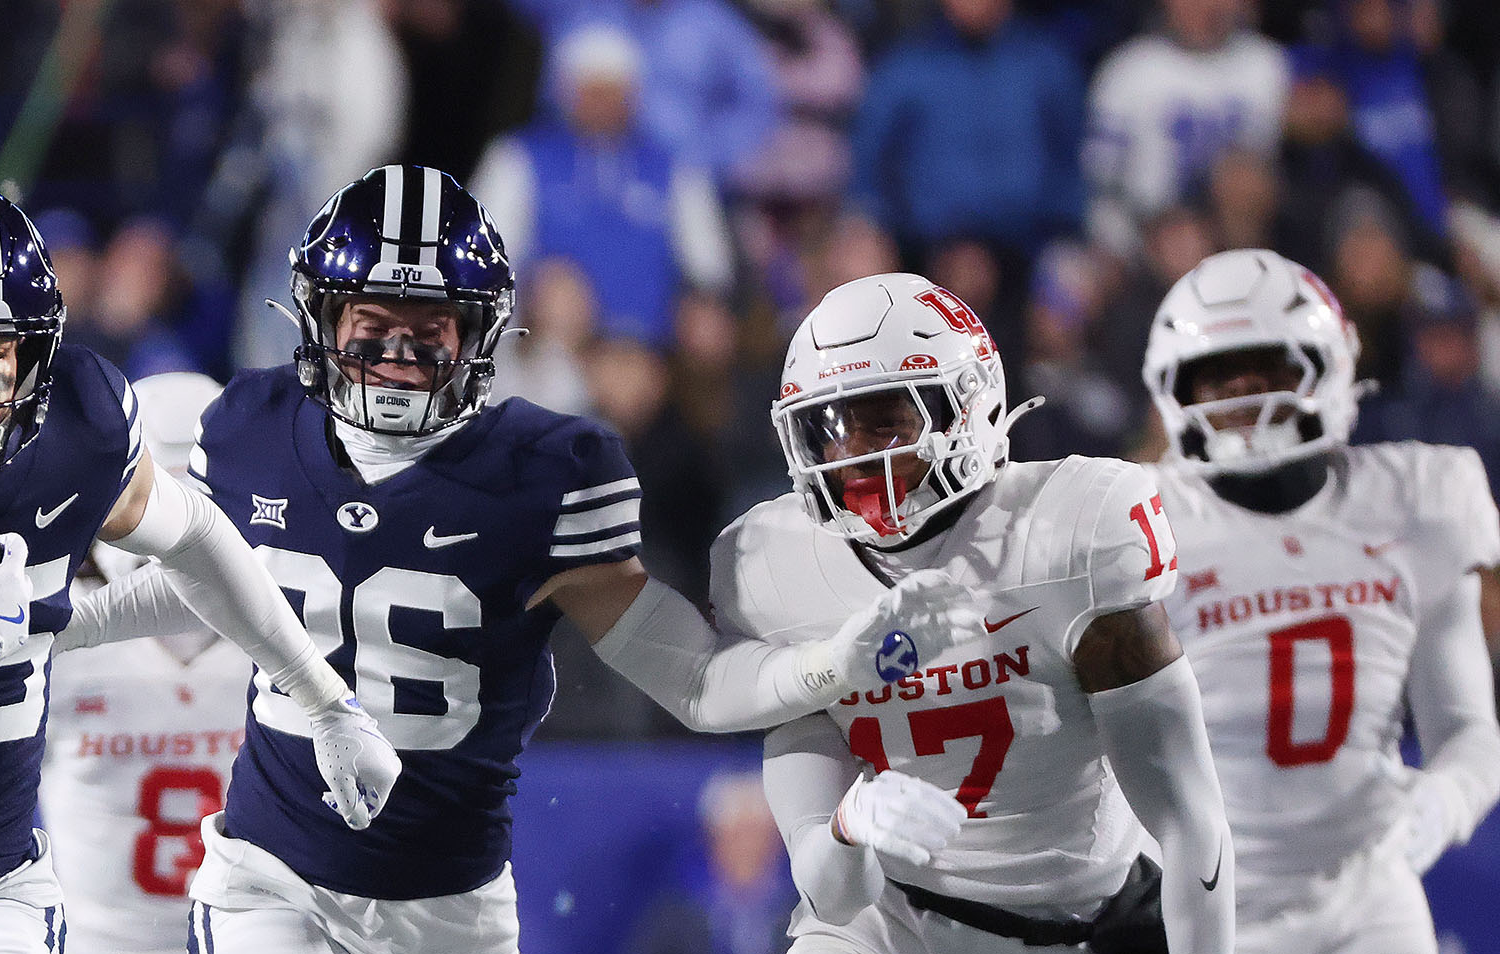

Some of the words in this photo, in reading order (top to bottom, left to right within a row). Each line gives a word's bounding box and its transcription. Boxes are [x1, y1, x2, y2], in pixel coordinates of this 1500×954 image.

[392, 267, 422, 284] BYU
[253, 499, 285, 526] XII
[342, 503, 376, 530] Y
[1197, 576, 1400, 631] HOUSTON
[1267, 613, 1354, 768] 0
[132, 765, 223, 898] 8
